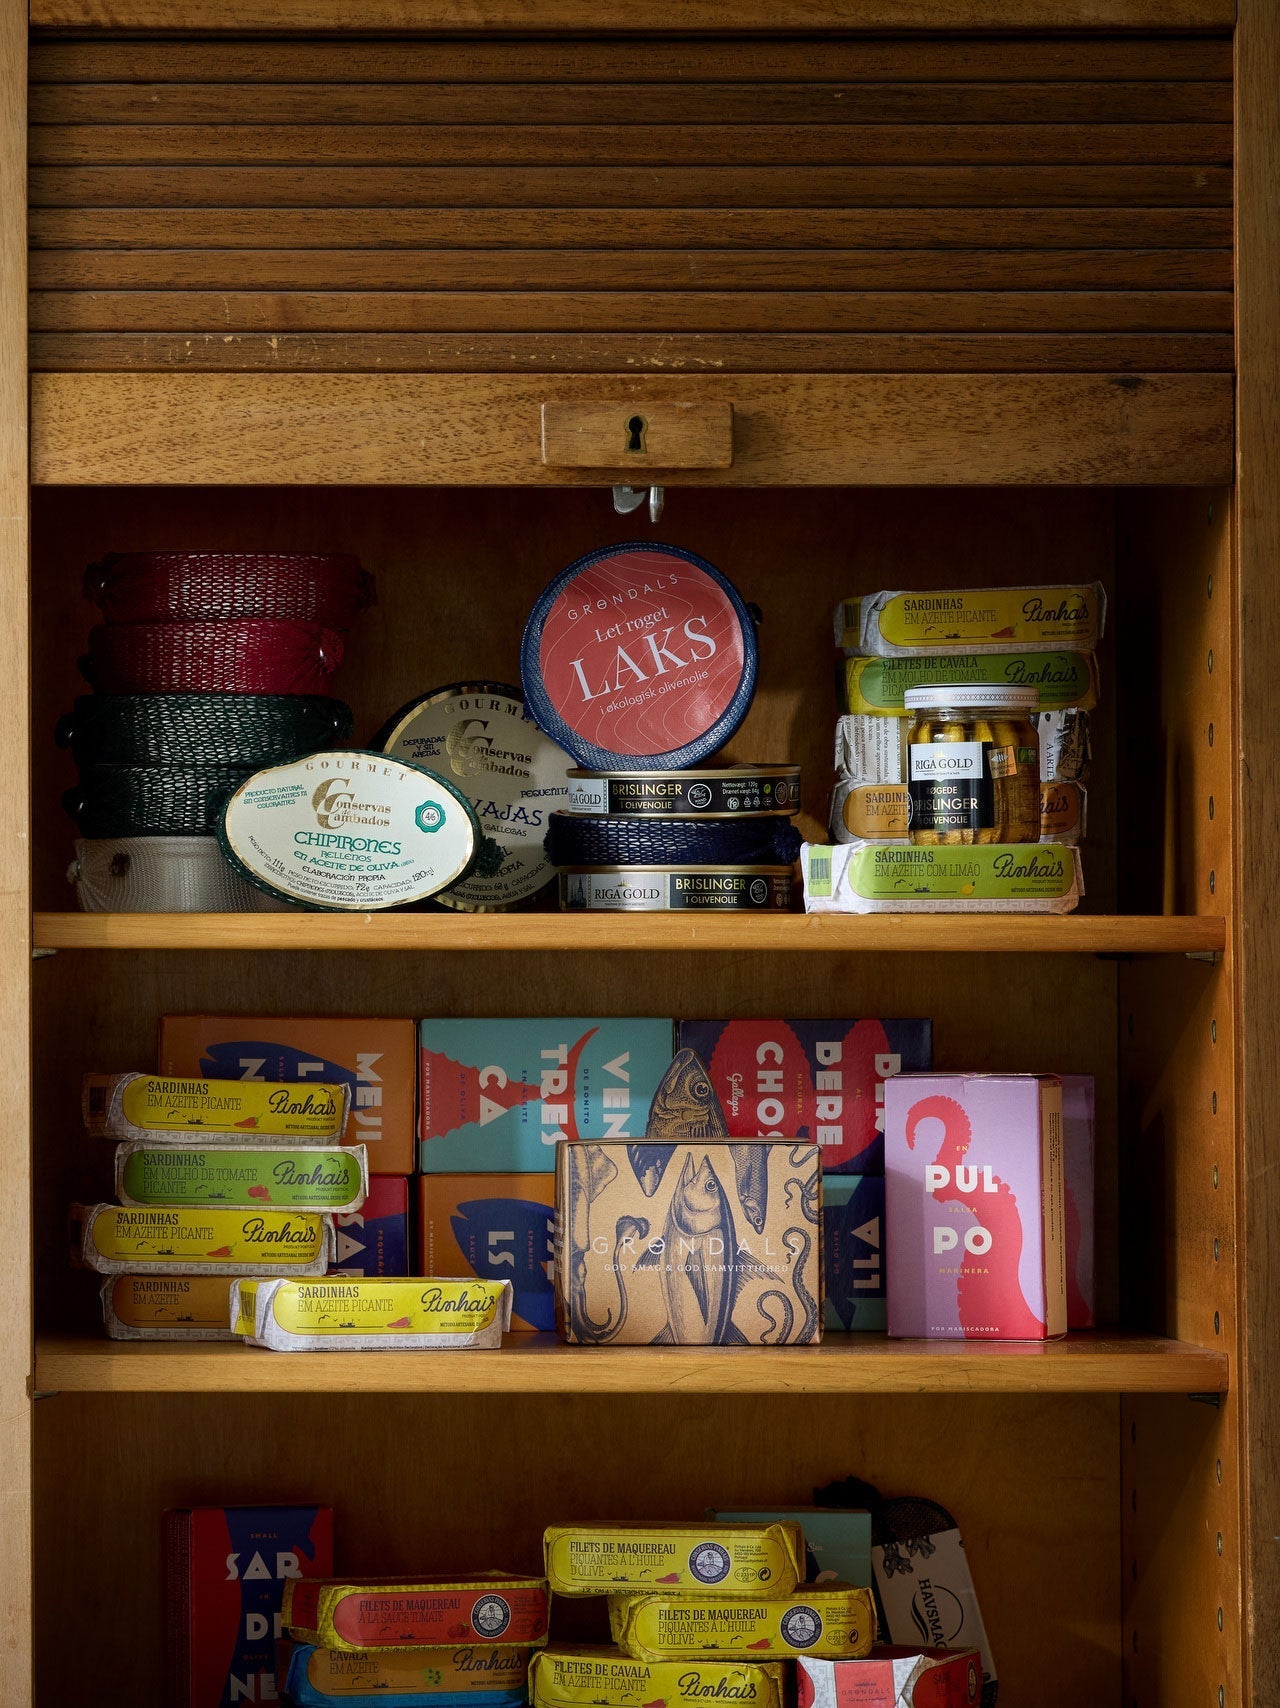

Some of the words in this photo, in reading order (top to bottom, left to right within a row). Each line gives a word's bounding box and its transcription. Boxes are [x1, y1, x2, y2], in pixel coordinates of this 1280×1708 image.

[567, 573, 678, 620] GRØNDALS
[904, 598, 963, 610] SARDINHAS
[904, 612, 920, 624] EM
[921, 611, 955, 623] AZEITE
[956, 609, 996, 622] PICANTE
[1022, 598, 1089, 623] Pinhais
[595, 624, 624, 642] Let
[627, 606, 670, 630] røget
[569, 615, 717, 702] LAKS
[600, 705, 605, 715] i
[606, 688, 656, 714] økologisk
[659, 670, 709, 695] olivenolie
[306, 760, 407, 782] GOURMET
[915, 758, 936, 770] RIGA
[938, 758, 973, 770] GOLD
[612, 783, 682, 796] BRISLINGER
[624, 801, 672, 809] OLIVENOLIE
[294, 831, 402, 856] CHIPIRONES
[309, 855, 347, 871] ACEITE
[349, 864, 364, 872] DE
[367, 862, 400, 871] OLIVA
[320, 851, 372, 863] RELLENOS
[875, 850, 934, 862] SARDINHAS
[992, 852, 1064, 878] Pinhais
[594, 889, 621, 900] RIGA
[623, 889, 660, 900] GOLD
[676, 879, 746, 890] BRISLINGER
[691, 896, 738, 904] OLIVENOLIE
[148, 1082, 208, 1095] SARDINHAS
[356, 1052, 384, 1141] MEJI
[479, 1065, 509, 1127] CA
[540, 1044, 568, 1146] TRES
[601, 1052, 630, 1138] VEN
[816, 1041, 843, 1146] DERE
[148, 1095, 165, 1107] EM
[166, 1096, 198, 1109] AZEITE
[200, 1097, 241, 1110] PICANTE
[268, 1089, 336, 1116] Pinhais
[925, 1165, 998, 1193] PUL
[592, 1236, 804, 1256] GRØNDALS
[933, 1226, 993, 1256] PO
[298, 1286, 359, 1298] SARDINHAS
[420, 1288, 495, 1312] Pinhais
[570, 1542, 596, 1553] FILETS
[599, 1543, 615, 1554] DE
[617, 1543, 676, 1555] MAQUEREAU
[225, 1551, 303, 1581] SAR
[554, 1661, 586, 1675] FILETES
[590, 1664, 607, 1675] DE
[610, 1664, 651, 1678] CAVALA
[678, 1671, 758, 1700] Pinhais
